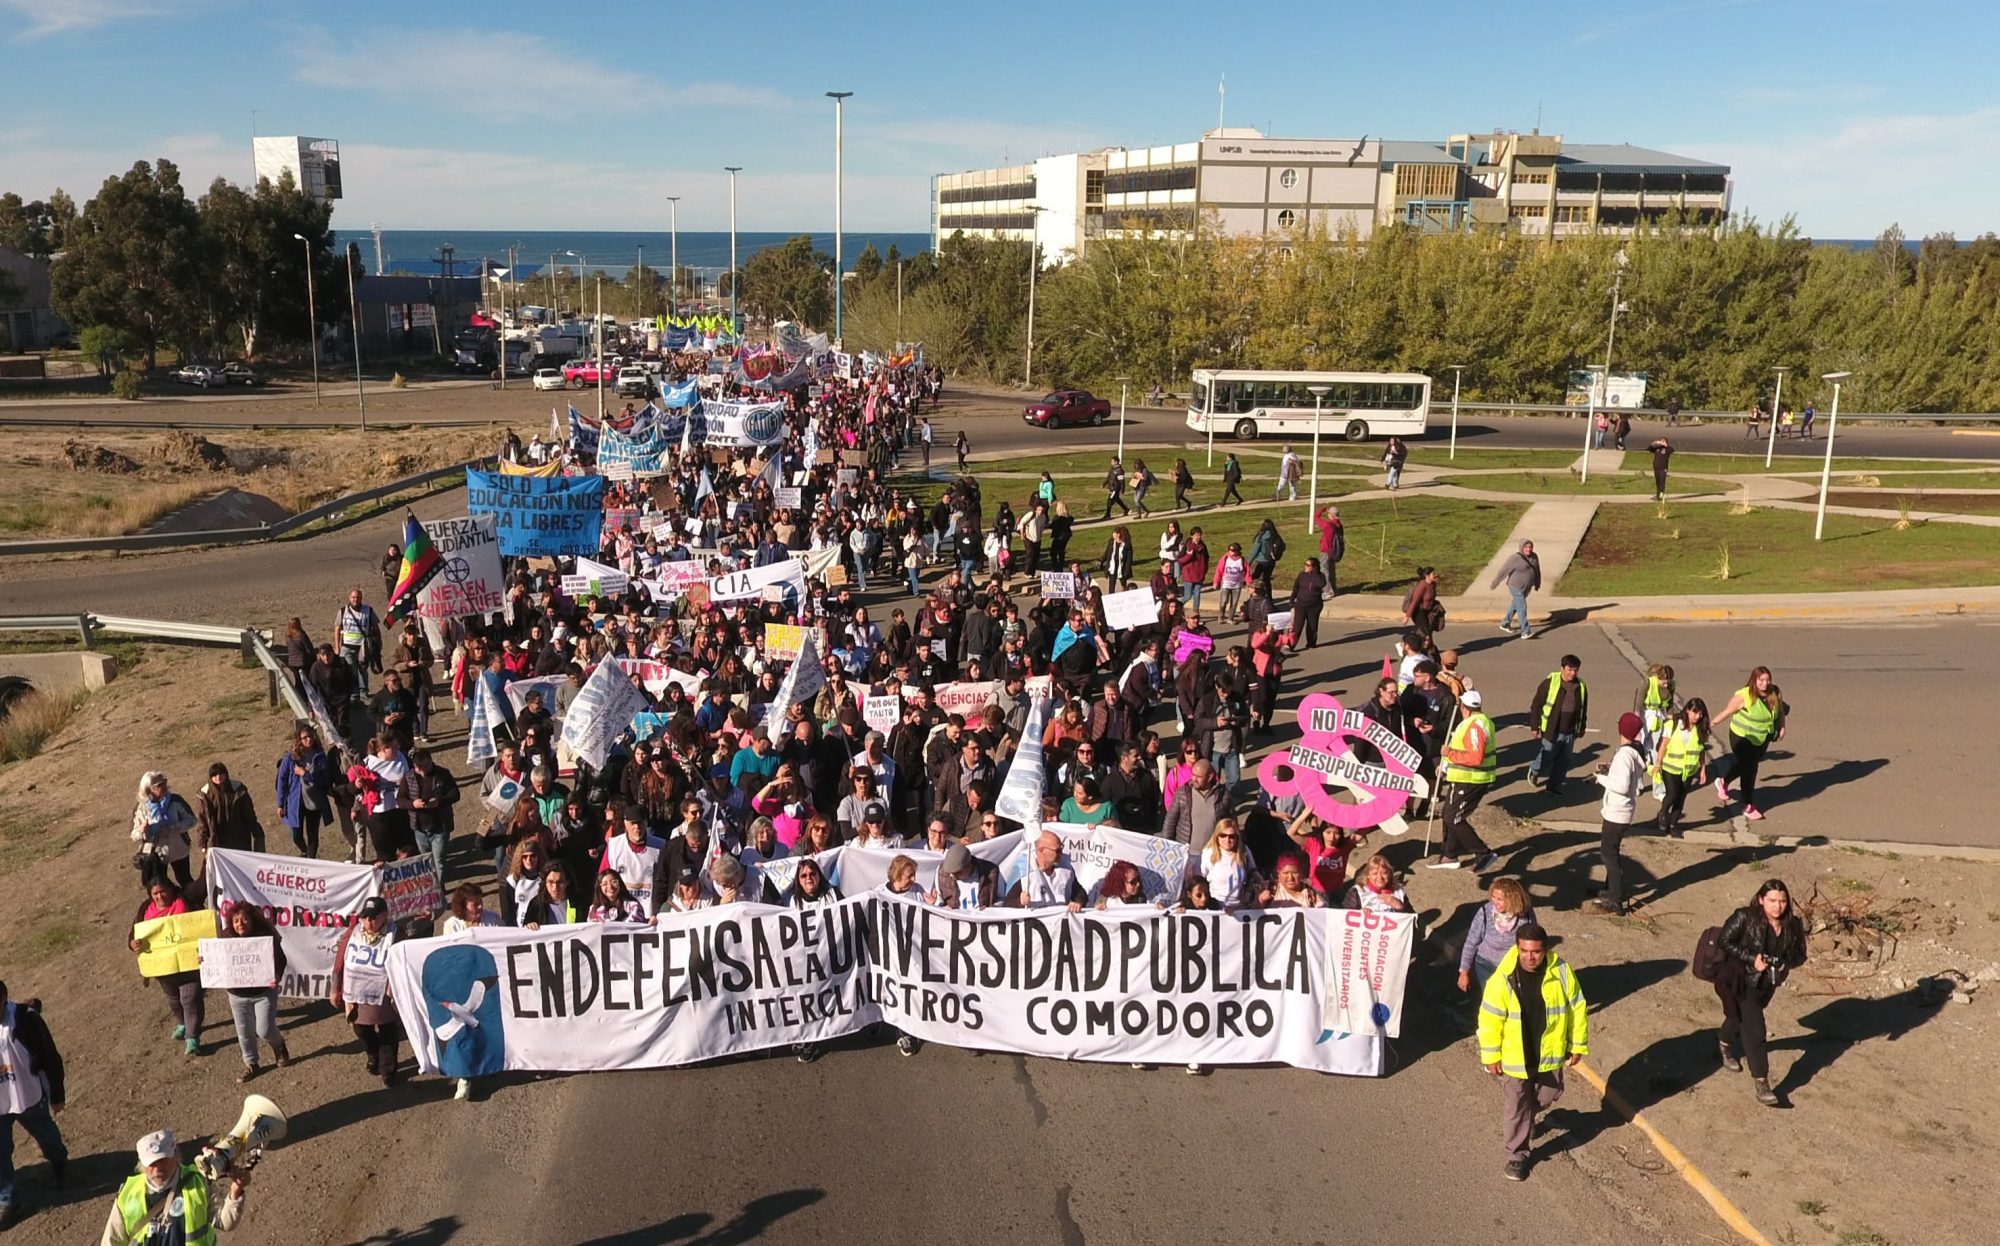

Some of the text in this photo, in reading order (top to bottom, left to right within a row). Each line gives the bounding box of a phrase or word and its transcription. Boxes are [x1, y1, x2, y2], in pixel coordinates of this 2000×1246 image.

[487, 474, 570, 494] SOLO LA
[469, 489, 601, 510] EDUCACION NOS
[425, 519, 478, 539] FUERZA
[521, 510, 584, 531] LIBRES
[433, 529, 495, 555] UDIANTIL
[940, 693, 990, 706] CIENCIAS
[1312, 709, 1421, 771] NO AL RECORTE
[1290, 745, 1414, 791] PRESUPUESTARIO
[1069, 839, 1107, 854] Mi Uni
[256, 869, 326, 894] GÉNEROS
[779, 910, 820, 949] DE
[232, 954, 262, 966] FUERZA
[822, 898, 1112, 994] UNIVERSIDAD
[1339, 910, 1362, 1010] UNIVERSITARIOS
[1359, 912, 1380, 981] DOCENTES
[1373, 916, 1398, 992] ASOCIACION
[785, 952, 828, 985] LA
[726, 970, 1275, 1038] INTERCLAUSTROS COMODORO
